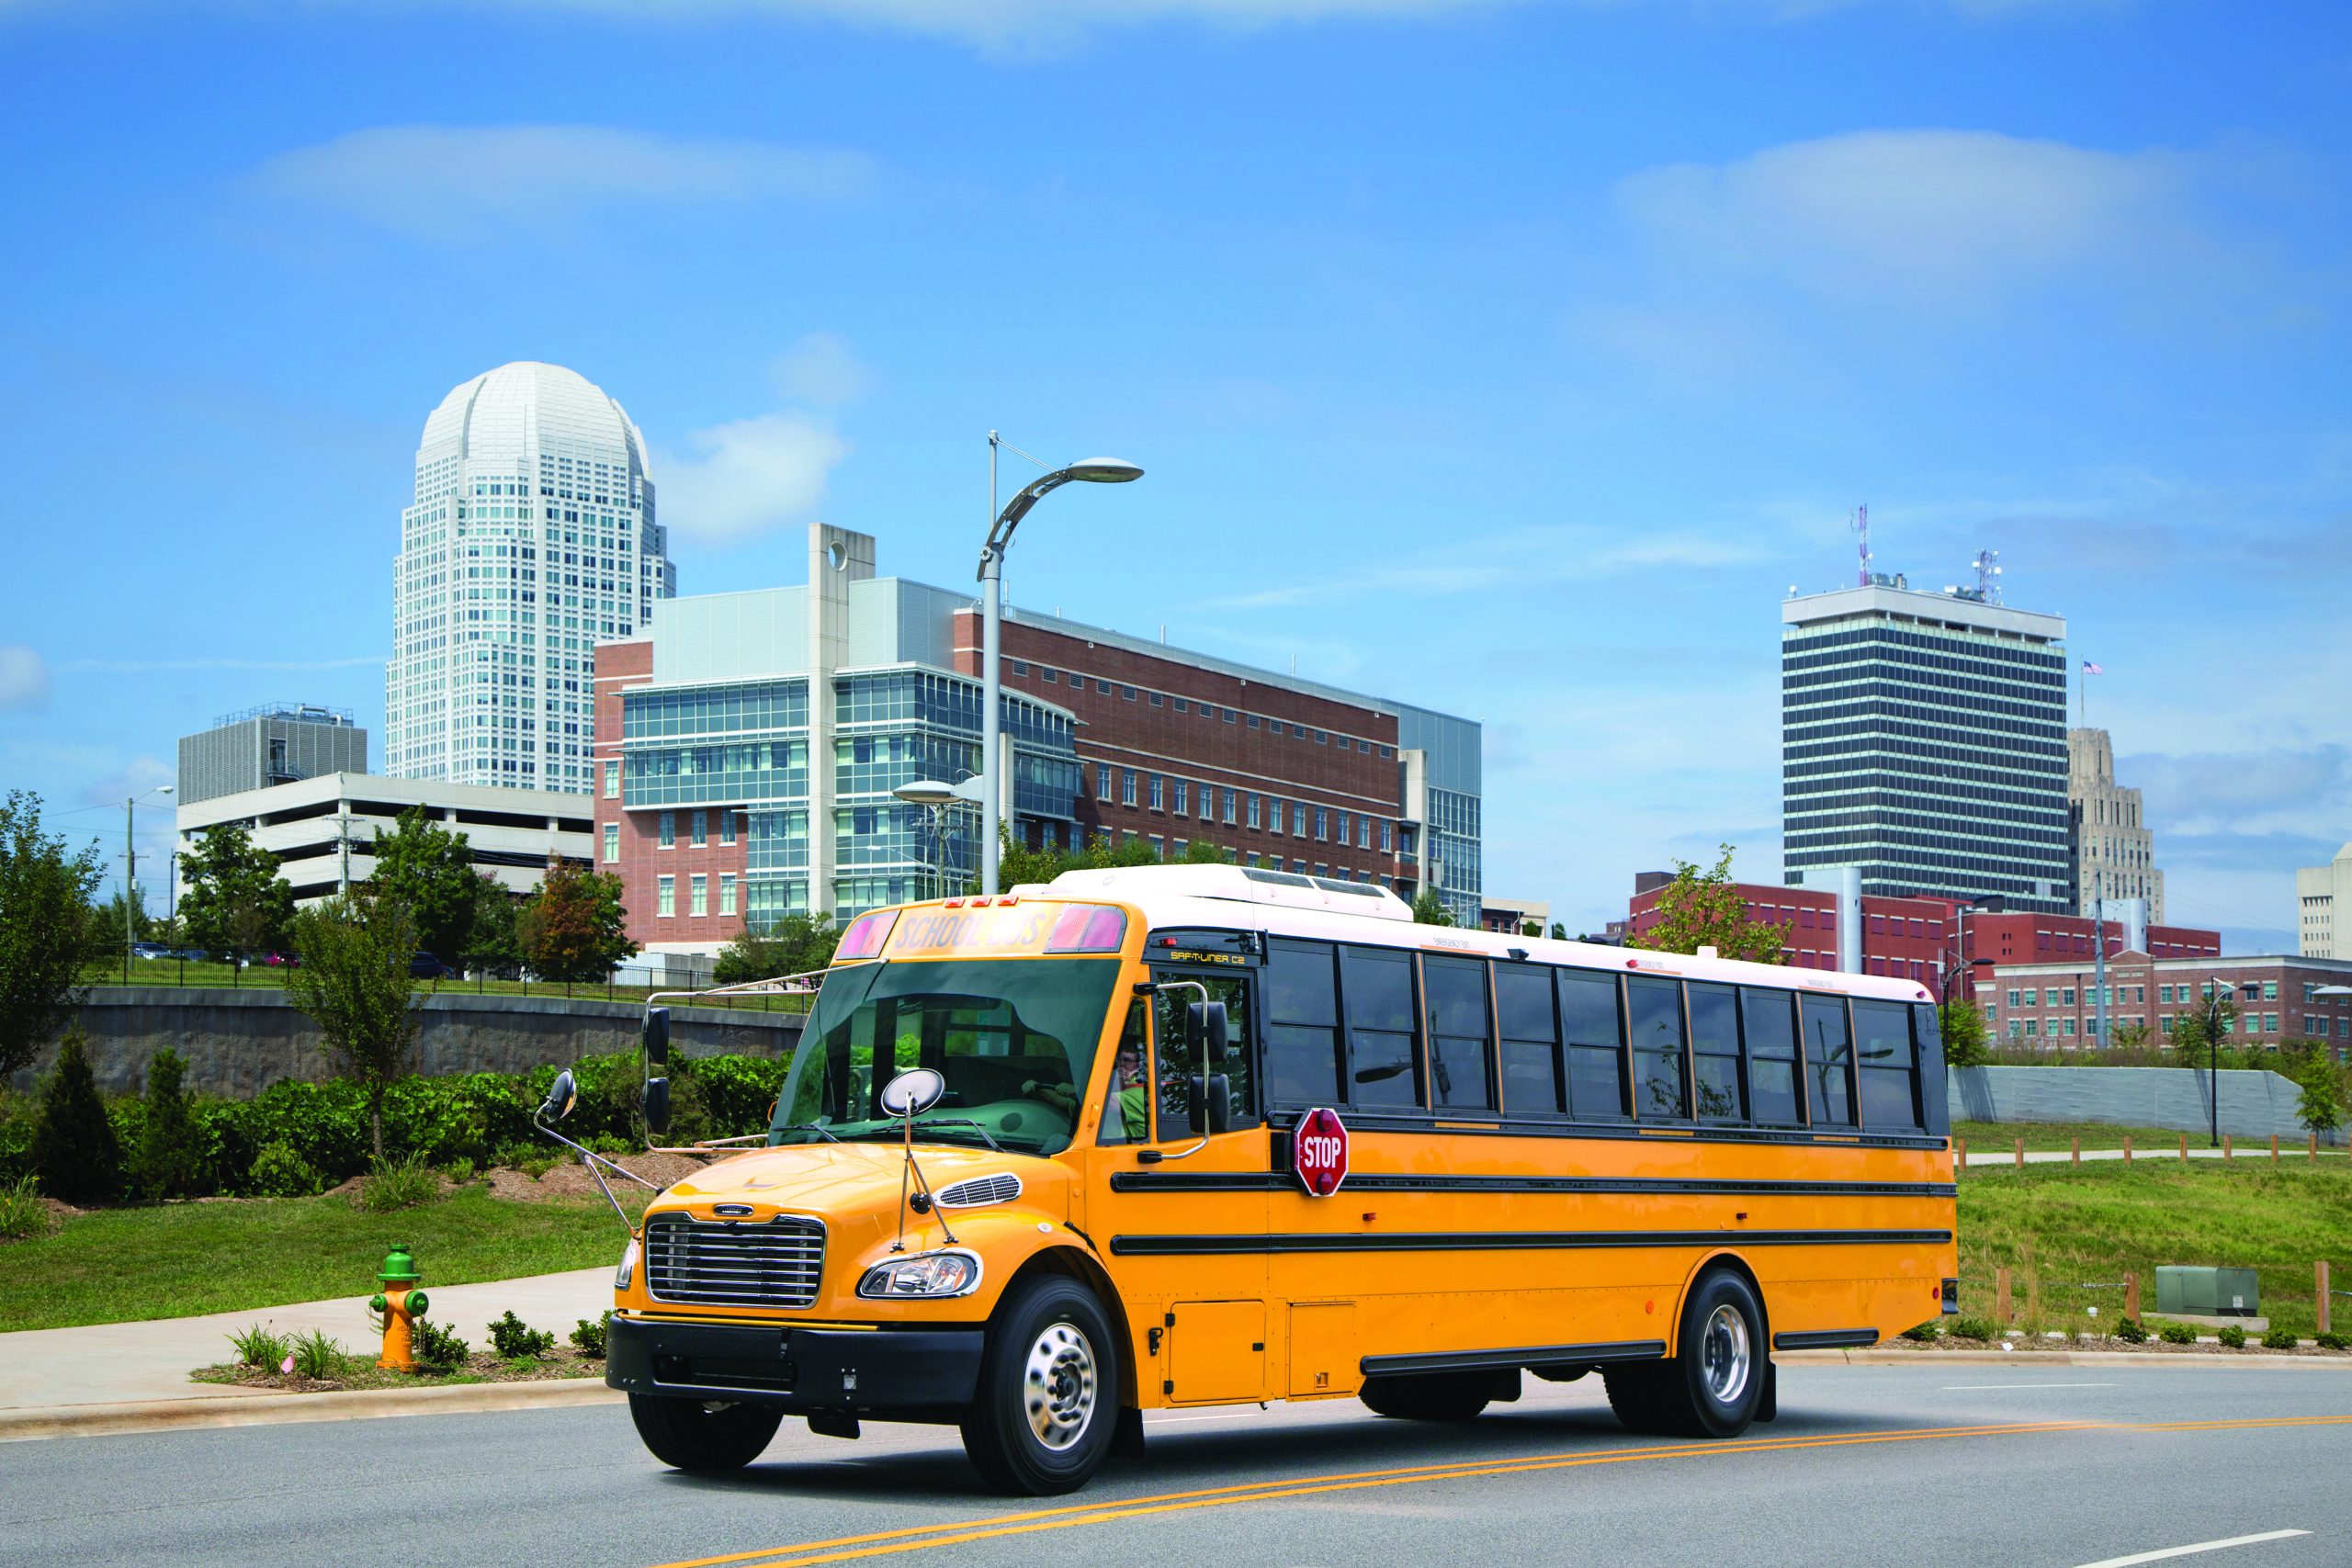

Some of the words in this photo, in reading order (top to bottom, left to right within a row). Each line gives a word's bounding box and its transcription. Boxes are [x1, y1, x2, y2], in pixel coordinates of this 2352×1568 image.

[895, 914, 984, 949] SCHOOL
[1231, 956, 1245, 964] C2
[1305, 1136, 1341, 1168] STOP
